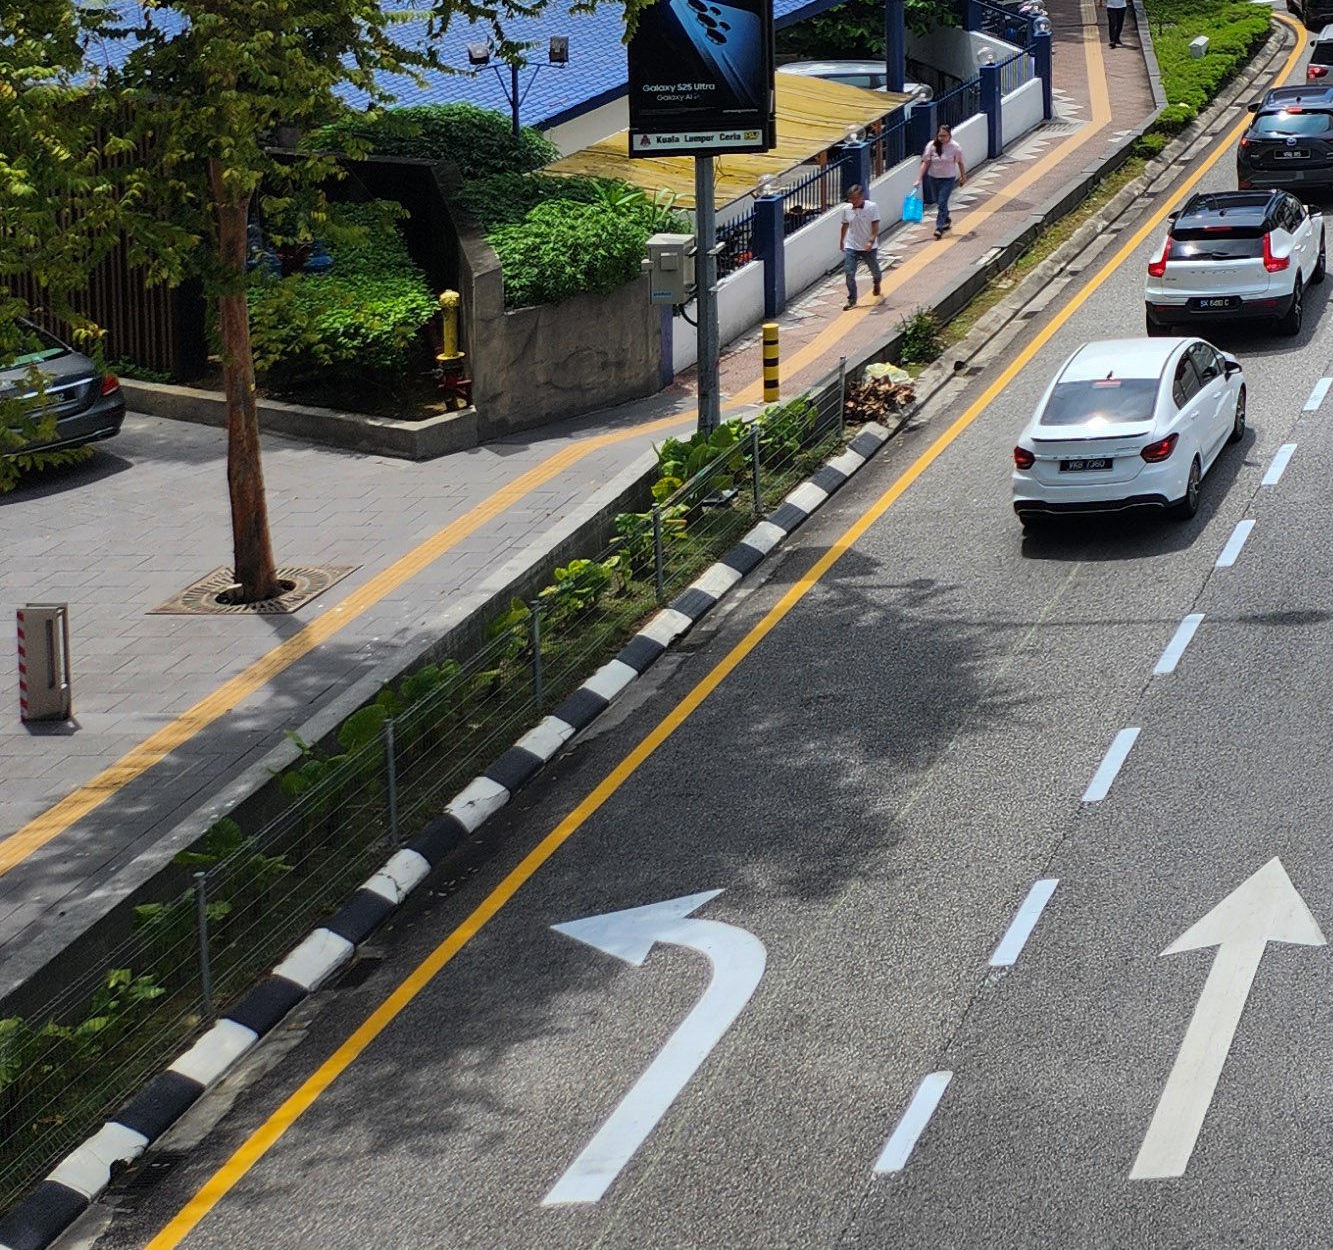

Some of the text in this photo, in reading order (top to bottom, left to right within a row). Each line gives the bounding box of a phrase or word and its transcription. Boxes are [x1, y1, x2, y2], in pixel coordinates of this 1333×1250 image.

[642, 82, 716, 93] Galaxy S25 Ultra
[656, 135, 680, 144] Kuala
[684, 134, 714, 145] Lumpur
[719, 132, 741, 141] Ceria
